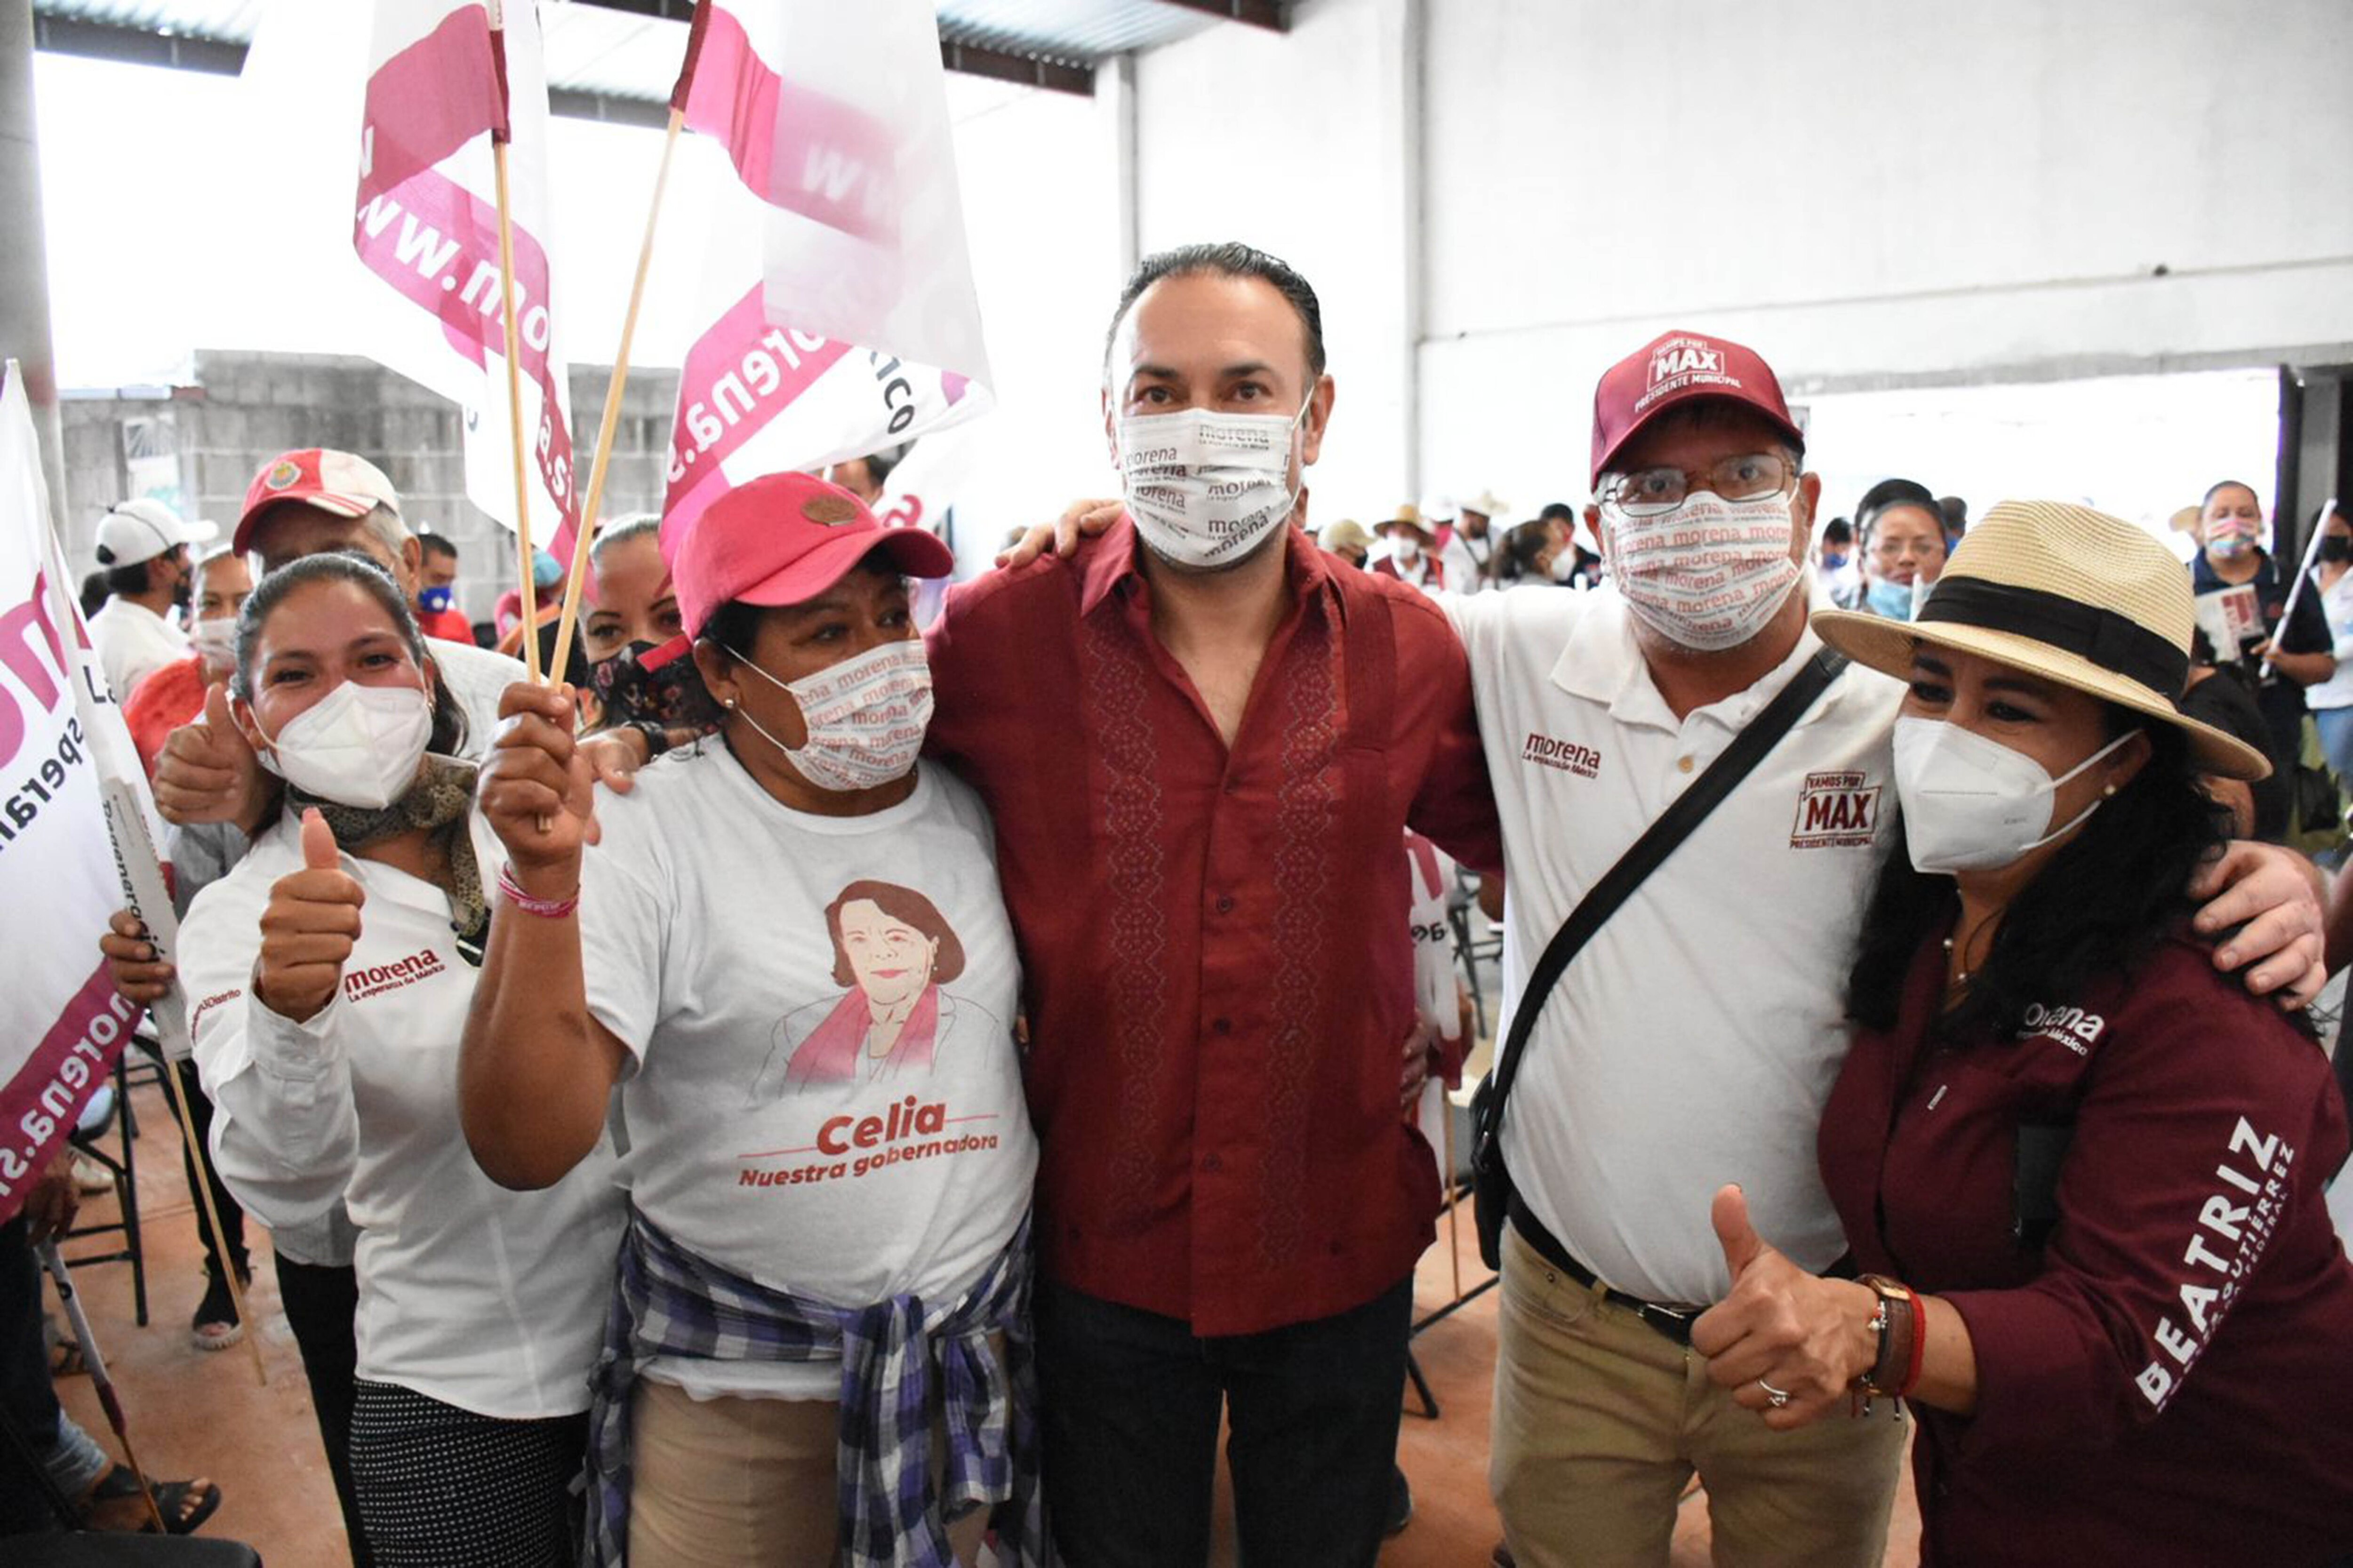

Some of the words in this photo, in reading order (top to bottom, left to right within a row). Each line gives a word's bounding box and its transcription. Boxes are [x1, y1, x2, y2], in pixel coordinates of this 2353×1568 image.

[1656, 349, 1719, 381] MAX
[1674, 529, 1742, 545] morena
[1677, 589, 1745, 613] morena
[1526, 733, 1601, 769] morena
[1804, 793, 1872, 831] MAX
[345, 949, 440, 993] morena
[816, 1095, 946, 1155] Celia
[738, 1162, 847, 1186] Nuestra
[853, 1134, 998, 1177] gobernadora
[2135, 1115, 2279, 1406] BEATRIZ
